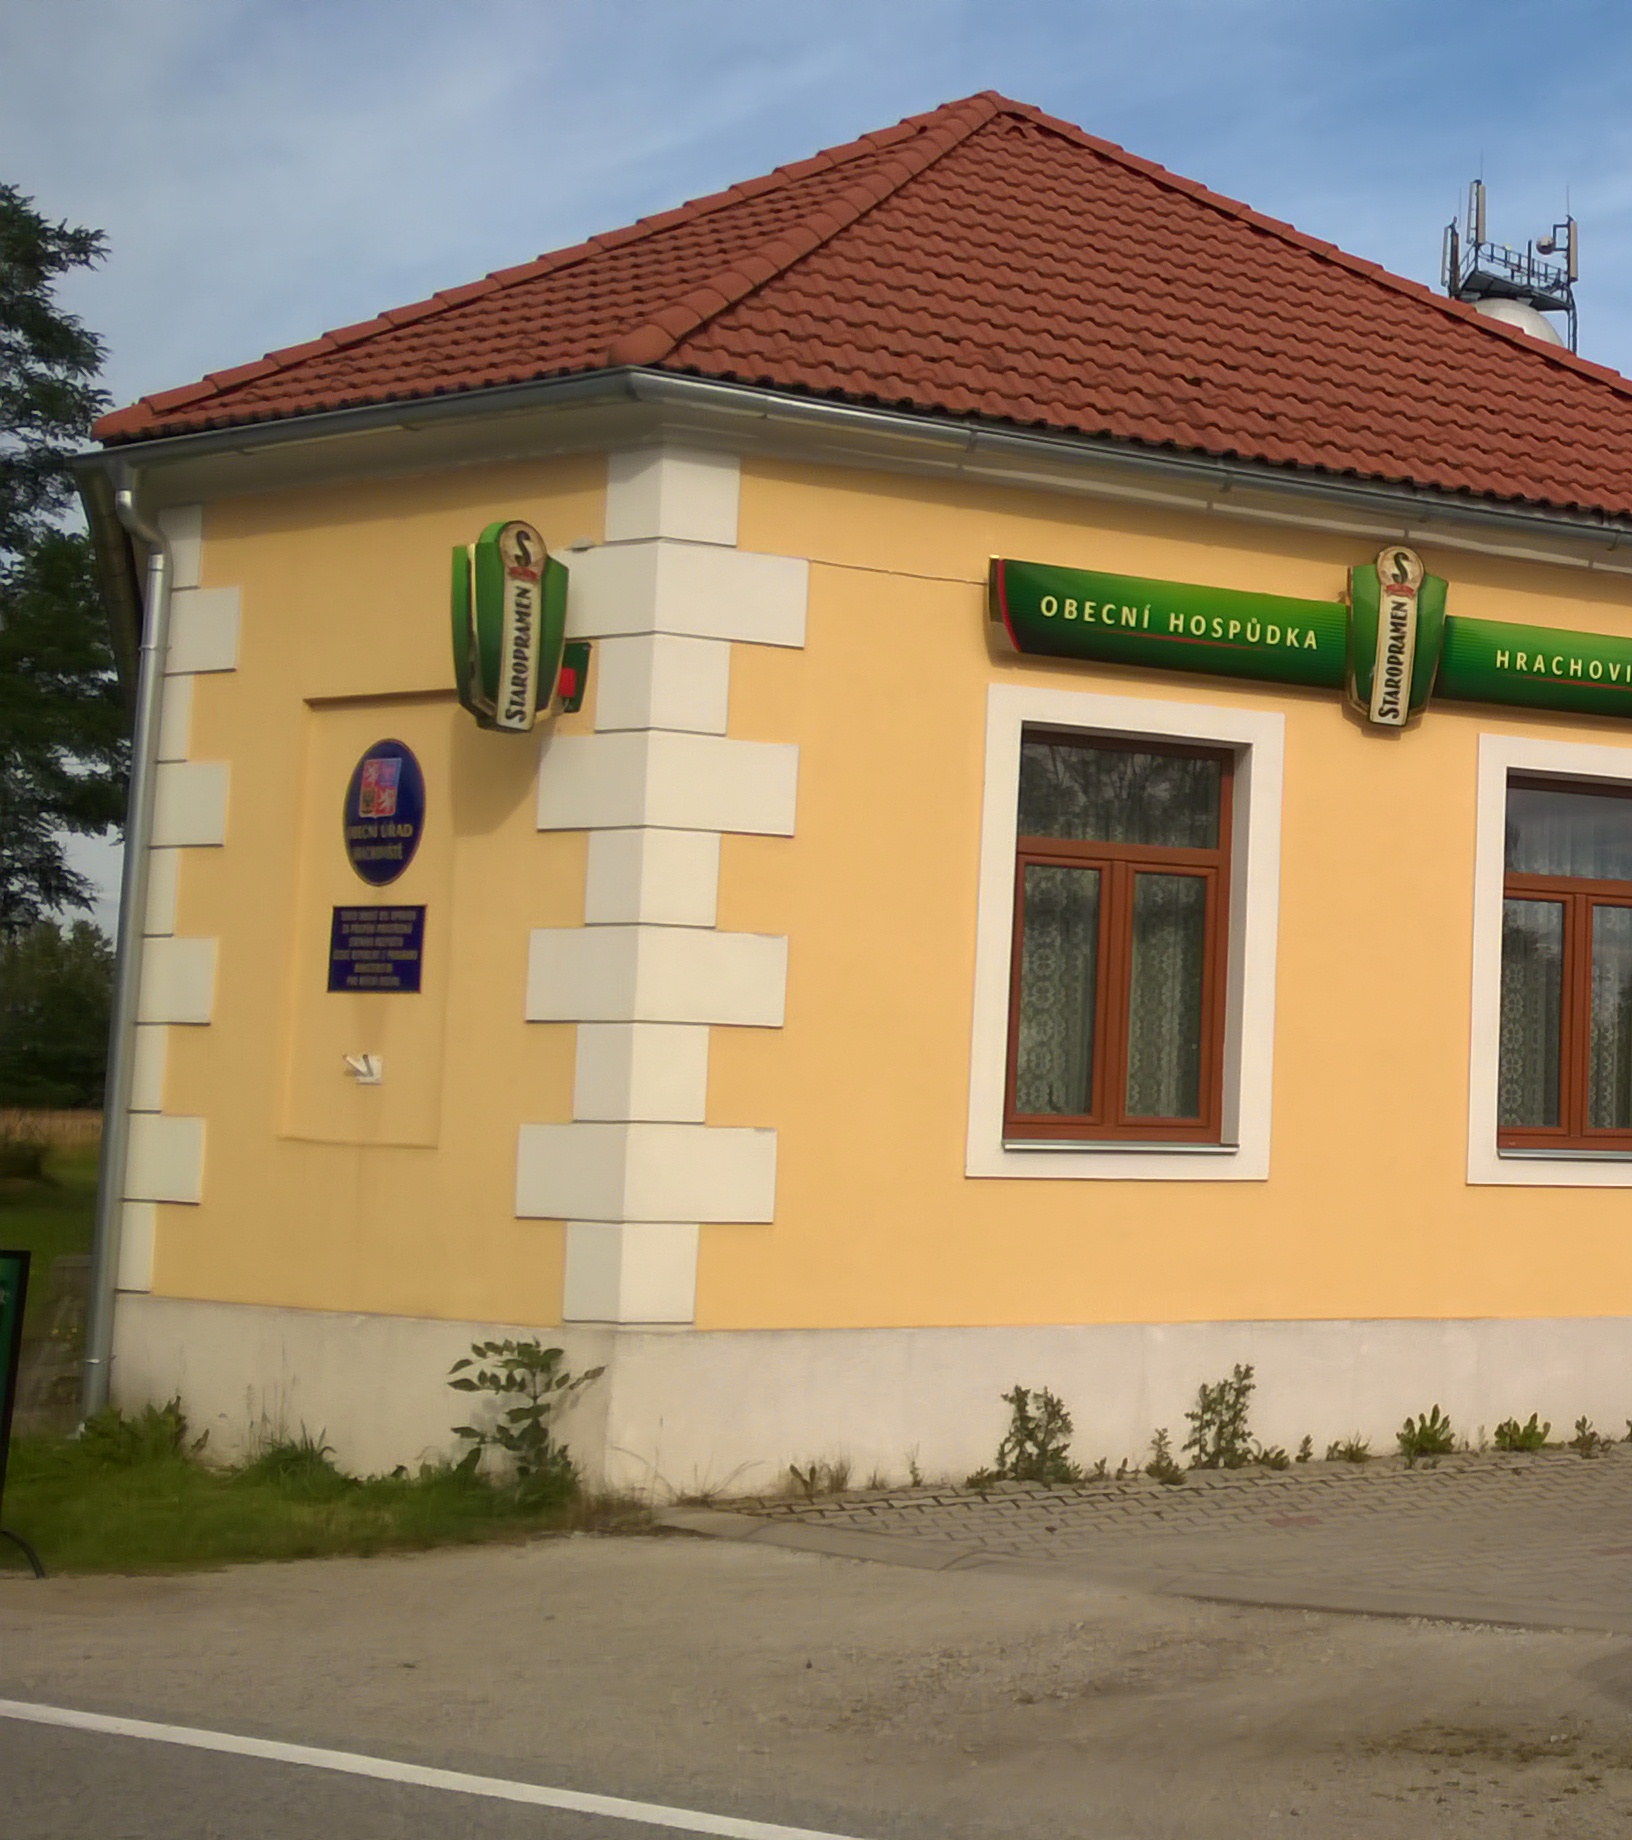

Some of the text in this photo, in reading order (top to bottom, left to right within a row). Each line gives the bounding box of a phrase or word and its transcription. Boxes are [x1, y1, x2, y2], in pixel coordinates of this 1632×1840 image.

[504, 585, 533, 723] STAROPRAMEN
[1040, 594, 1319, 651] OBECNÍ HOSPŮDKA
[1378, 600, 1409, 720] STAROPRAMEN
